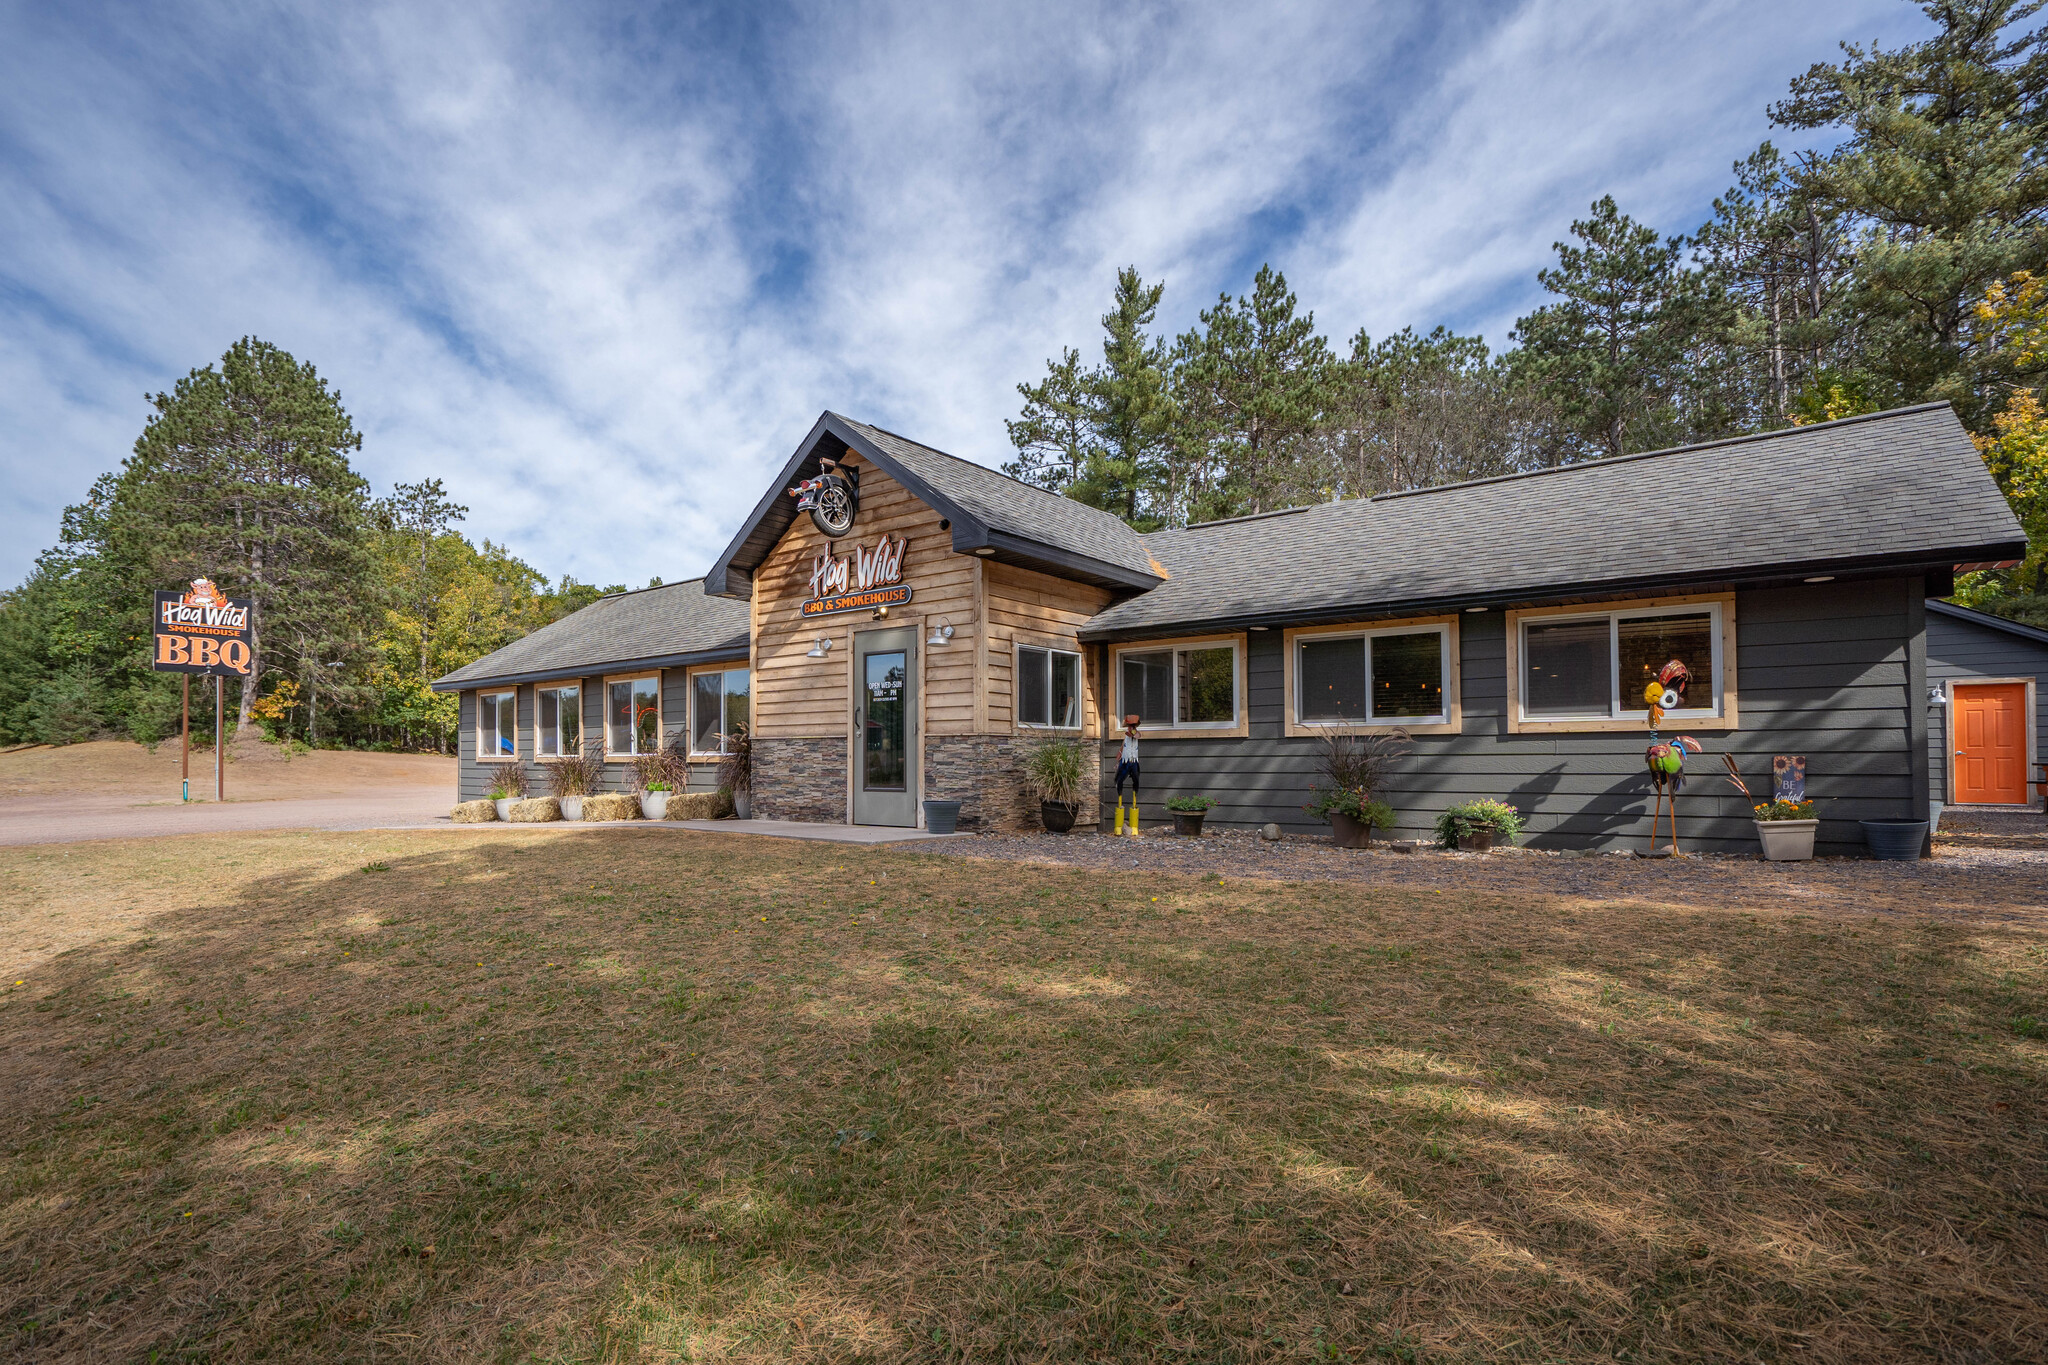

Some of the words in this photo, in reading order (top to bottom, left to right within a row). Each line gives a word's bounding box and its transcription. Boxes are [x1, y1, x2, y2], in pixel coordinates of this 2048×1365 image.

[809, 541, 849, 600] Hog
[856, 534, 907, 592] Wild
[804, 601, 824, 613] BBQ
[825, 600, 834, 610] &
[835, 589, 906, 609] SMOKEHOUSE
[162, 594, 202, 626] Hog
[205, 601, 248, 627] Wild
[168, 625, 241, 636] SMOKEHOUSE
[156, 634, 251, 674] BBQ
[881, 681, 902, 689] WED-SUN
[1783, 780, 1796, 790] BE
[1775, 791, 1804, 804] Grateful
